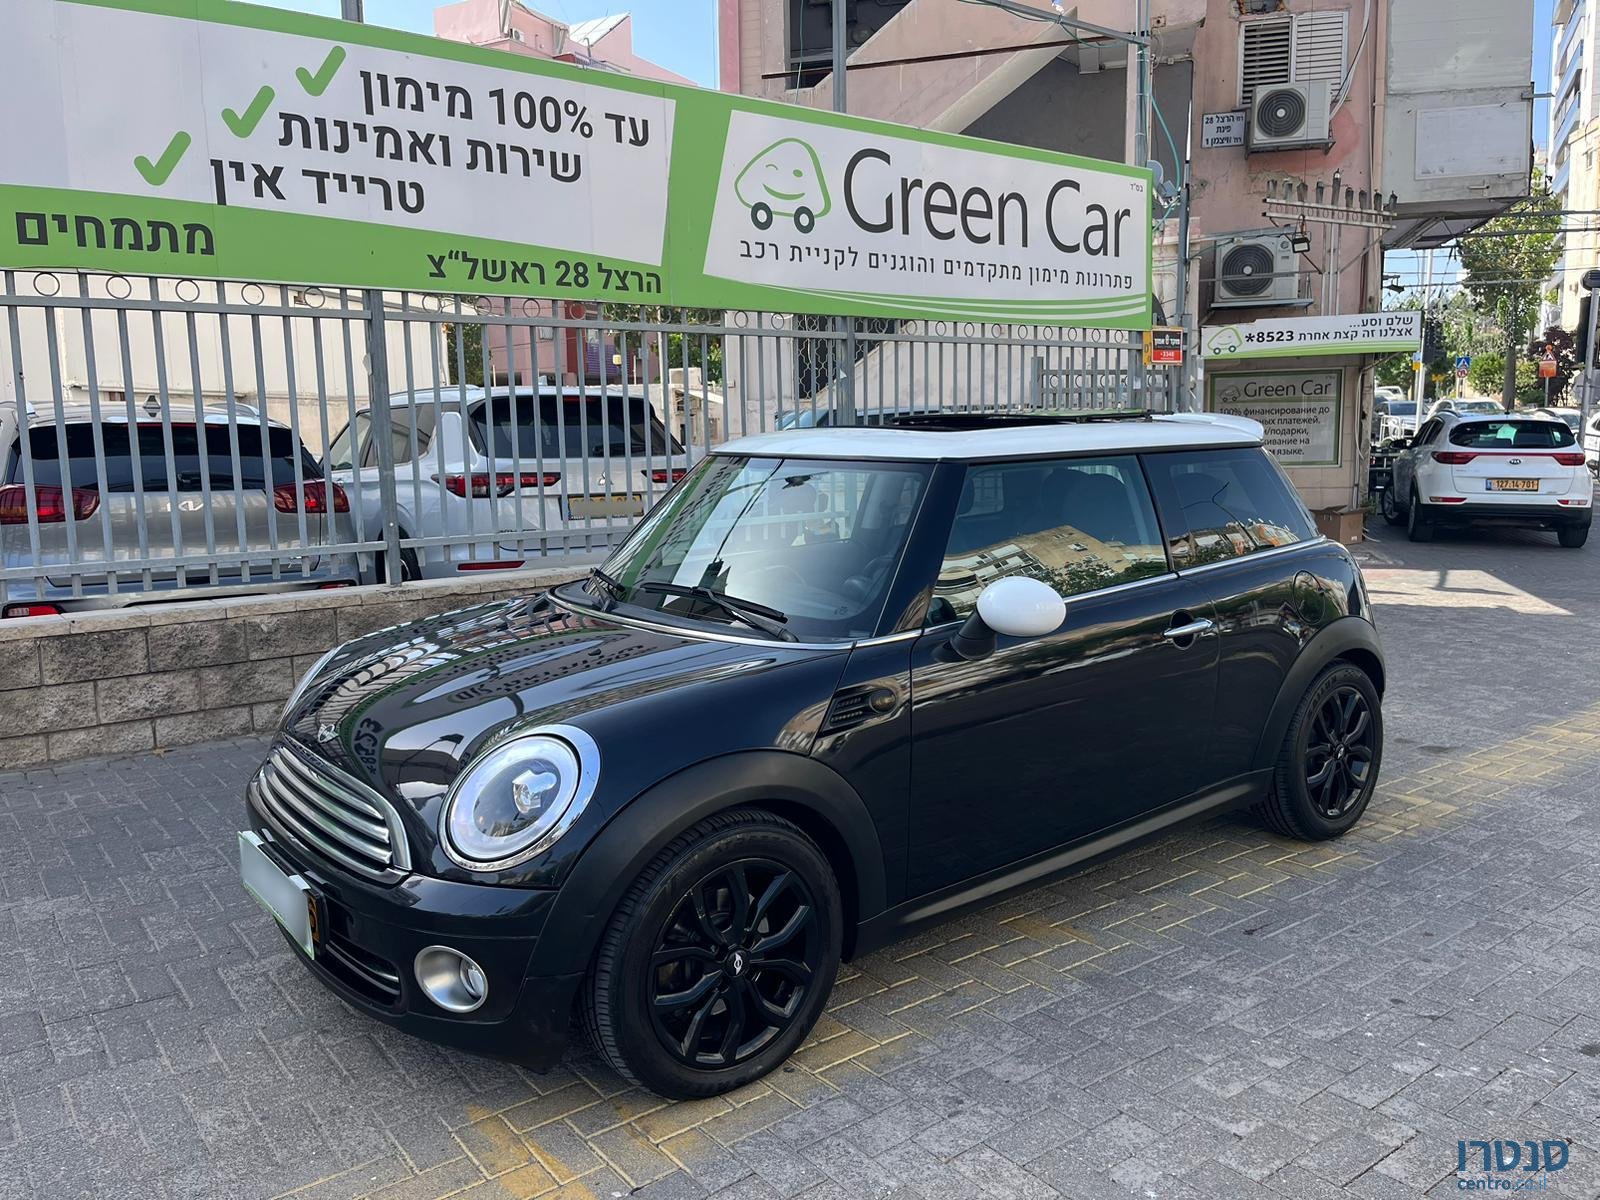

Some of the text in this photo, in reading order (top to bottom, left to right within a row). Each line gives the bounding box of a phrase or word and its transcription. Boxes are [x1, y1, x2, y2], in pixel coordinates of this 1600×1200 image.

[359, 70, 650, 147] עד 100% מימון
[278, 112, 582, 183] שירות ואמינות
[210, 158, 425, 214] טרייד אין
[843, 148, 1131, 258] Green Car
[15, 212, 215, 256] מתמחים
[554, 260, 589, 288] 28
[597, 262, 662, 293] הרצל
[740, 240, 1133, 289] פתרונות מימון מתקדמים והוגנים לקניית רכב
[1298, 326, 1413, 342] אצלנו זה קצת אחרת
[1386, 315, 1413, 326] שלם
[1243, 380, 1332, 398] Green Car
[1243, 406, 1317, 417] финансирование
[1318, 406, 1330, 414] до
